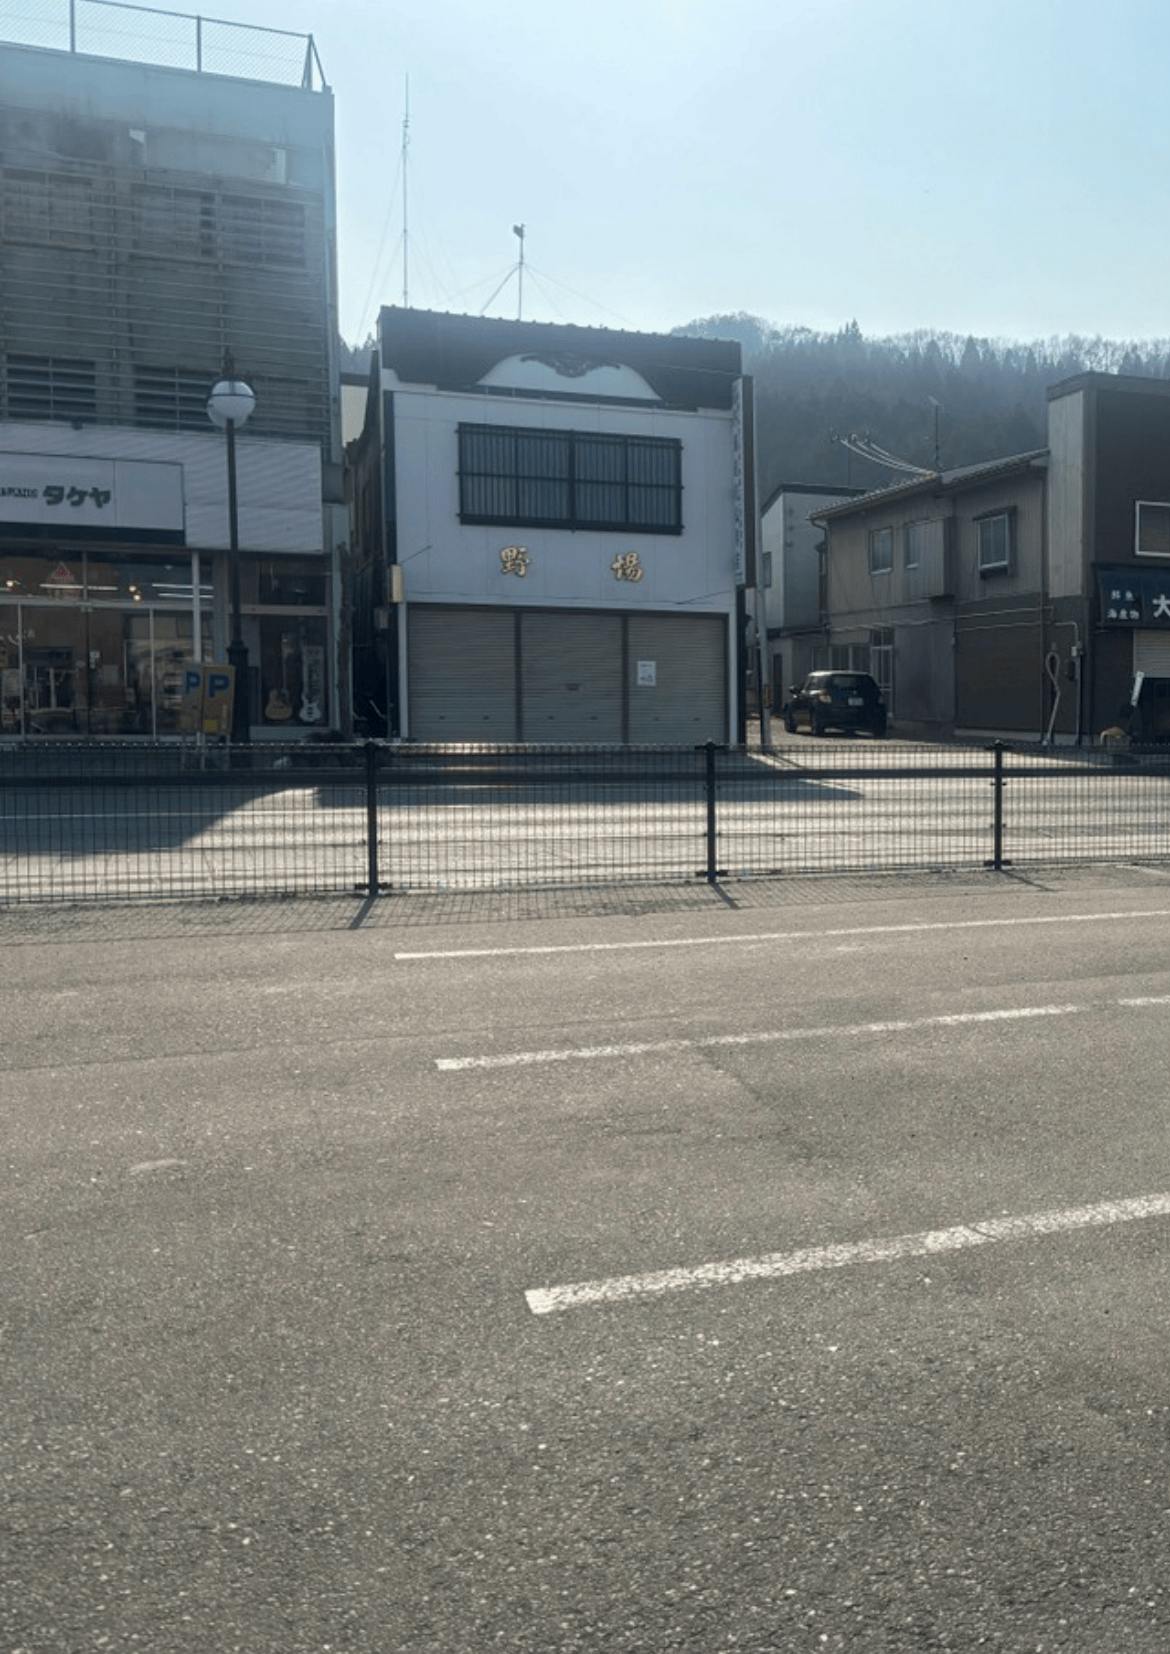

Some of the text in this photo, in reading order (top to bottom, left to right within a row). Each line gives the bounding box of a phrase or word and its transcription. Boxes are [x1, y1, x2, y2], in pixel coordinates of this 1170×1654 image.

[43, 485, 111, 509] タケヤ
[186, 671, 200, 693] P
[209, 675, 229, 698] P
